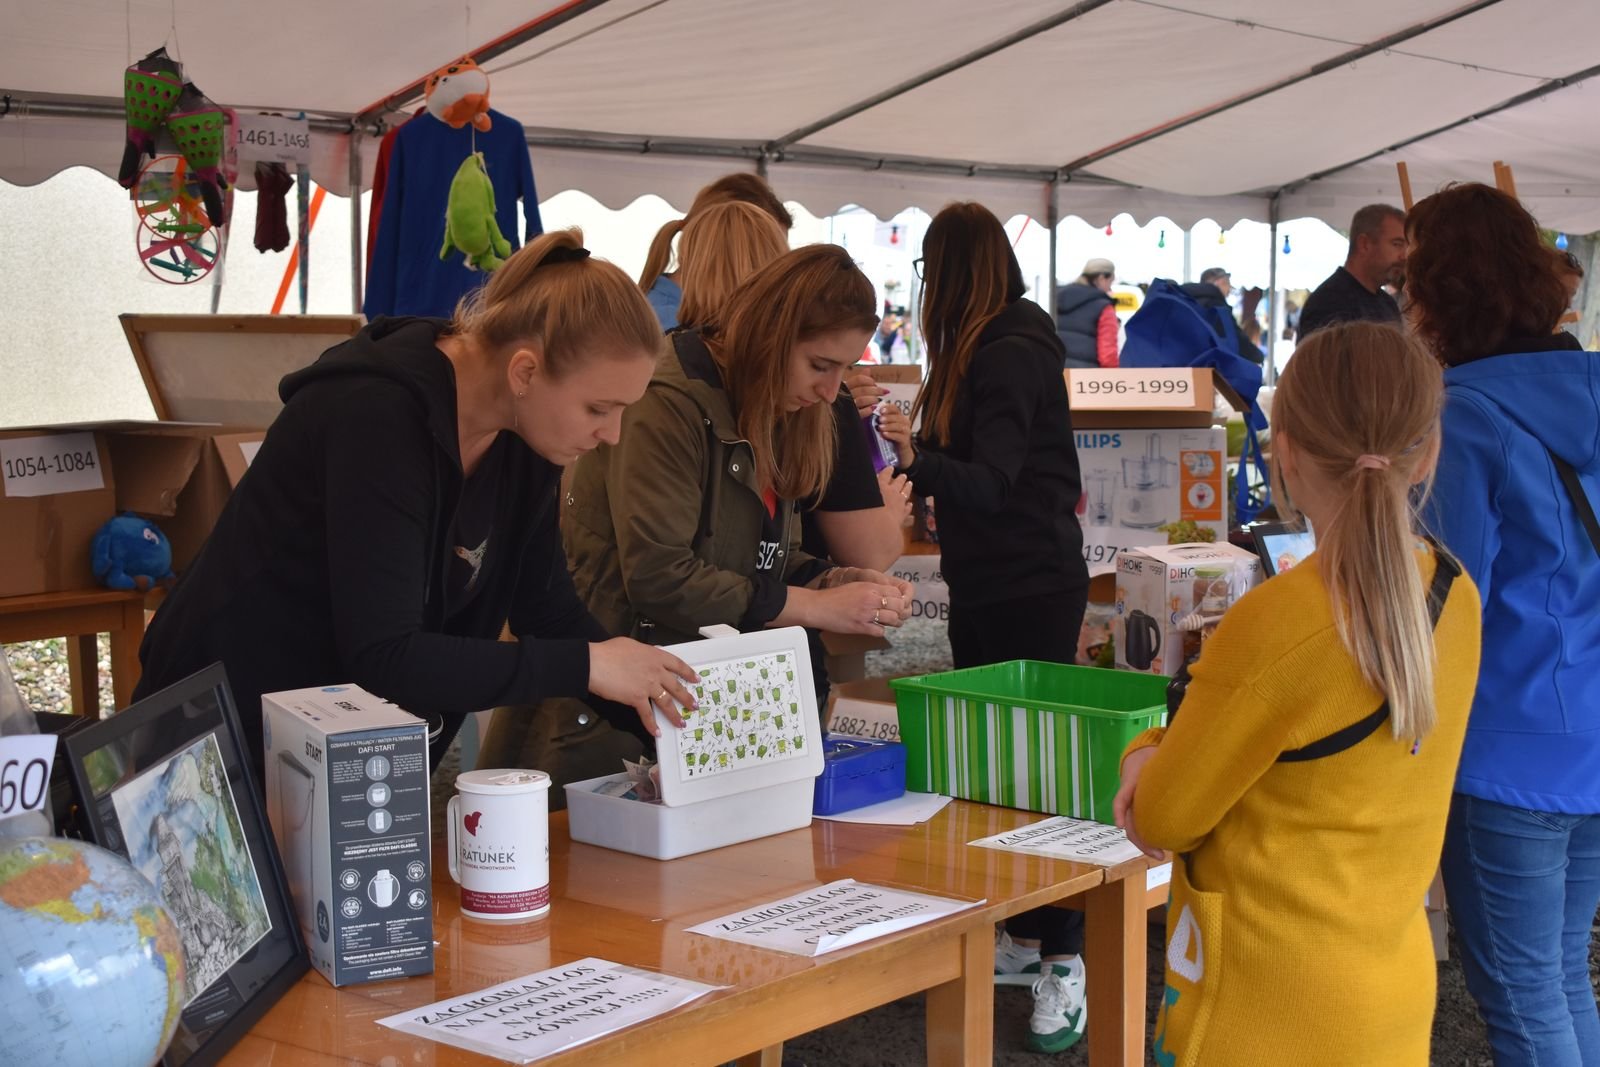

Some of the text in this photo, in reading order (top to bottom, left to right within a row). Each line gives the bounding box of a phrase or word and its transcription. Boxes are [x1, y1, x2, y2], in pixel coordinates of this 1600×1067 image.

[1076, 380, 1188, 394] 1996-1999
[1077, 433, 1121, 449] ILIPS
[6, 451, 96, 478] 1054-1084
[756, 541, 779, 570] SZ
[1084, 545, 1127, 564] 197
[1170, 567, 1196, 580] DIHO
[830, 715, 901, 742] 1882-189
[305, 741, 322, 764] START
[374, 743, 396, 753] START
[462, 849, 515, 864] RATUNEK
[414, 965, 596, 1024] ZACHOWAJ LOS
[444, 973, 622, 1031] NA LOSOWANIE
[501, 988, 616, 1029] NAGRODY
[506, 1002, 622, 1042] GŁÓWNEJ
